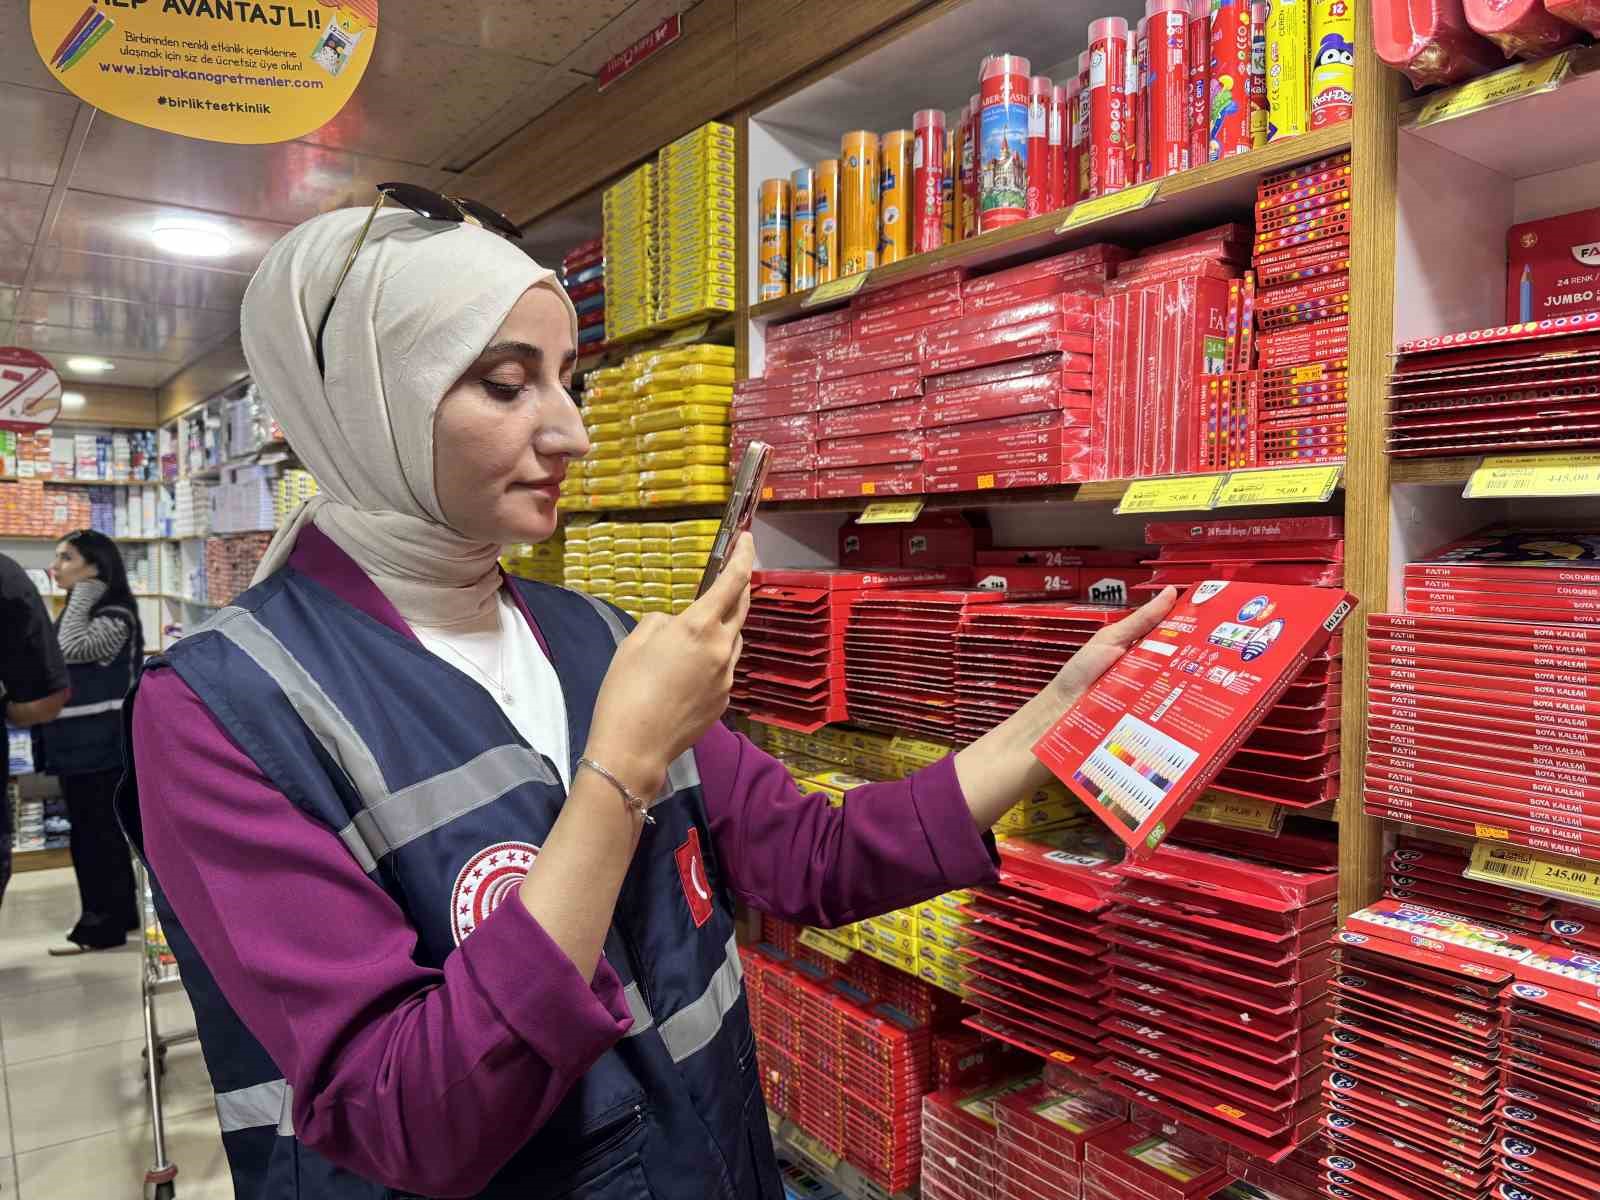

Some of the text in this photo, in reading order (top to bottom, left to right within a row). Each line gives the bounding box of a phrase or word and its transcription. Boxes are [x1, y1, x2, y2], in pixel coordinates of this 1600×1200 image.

[124, 30, 180, 47] Birbirinden
[184, 53, 198, 63] siz
[200, 54, 214, 64] de
[99, 62, 324, 89] www.izbirakanogretmenler.com
[157, 96, 272, 114] #birlikteetkinlik
[1570, 274, 1593, 285] RENK
[1543, 290, 1594, 307] JUMBO
[1044, 576, 1060, 591] 24
[1092, 584, 1122, 602] Pritt
[1534, 658, 1554, 666] BOYA
[1534, 672, 1554, 680] BOYA
[1534, 686, 1554, 694] BOYA
[1533, 700, 1554, 708] BOYA
[1534, 714, 1555, 722] BOYA
[1536, 728, 1556, 737] BOYA
[1533, 744, 1554, 752] BOYA
[1533, 758, 1554, 766] BOYA
[1535, 770, 1555, 778] BOYA
[1532, 784, 1553, 792] BOYA
[1530, 798, 1550, 807] BOYA
[1530, 812, 1550, 820] BOYA
[1530, 825, 1550, 834] BOYA
[1528, 838, 1549, 848] BOYA
